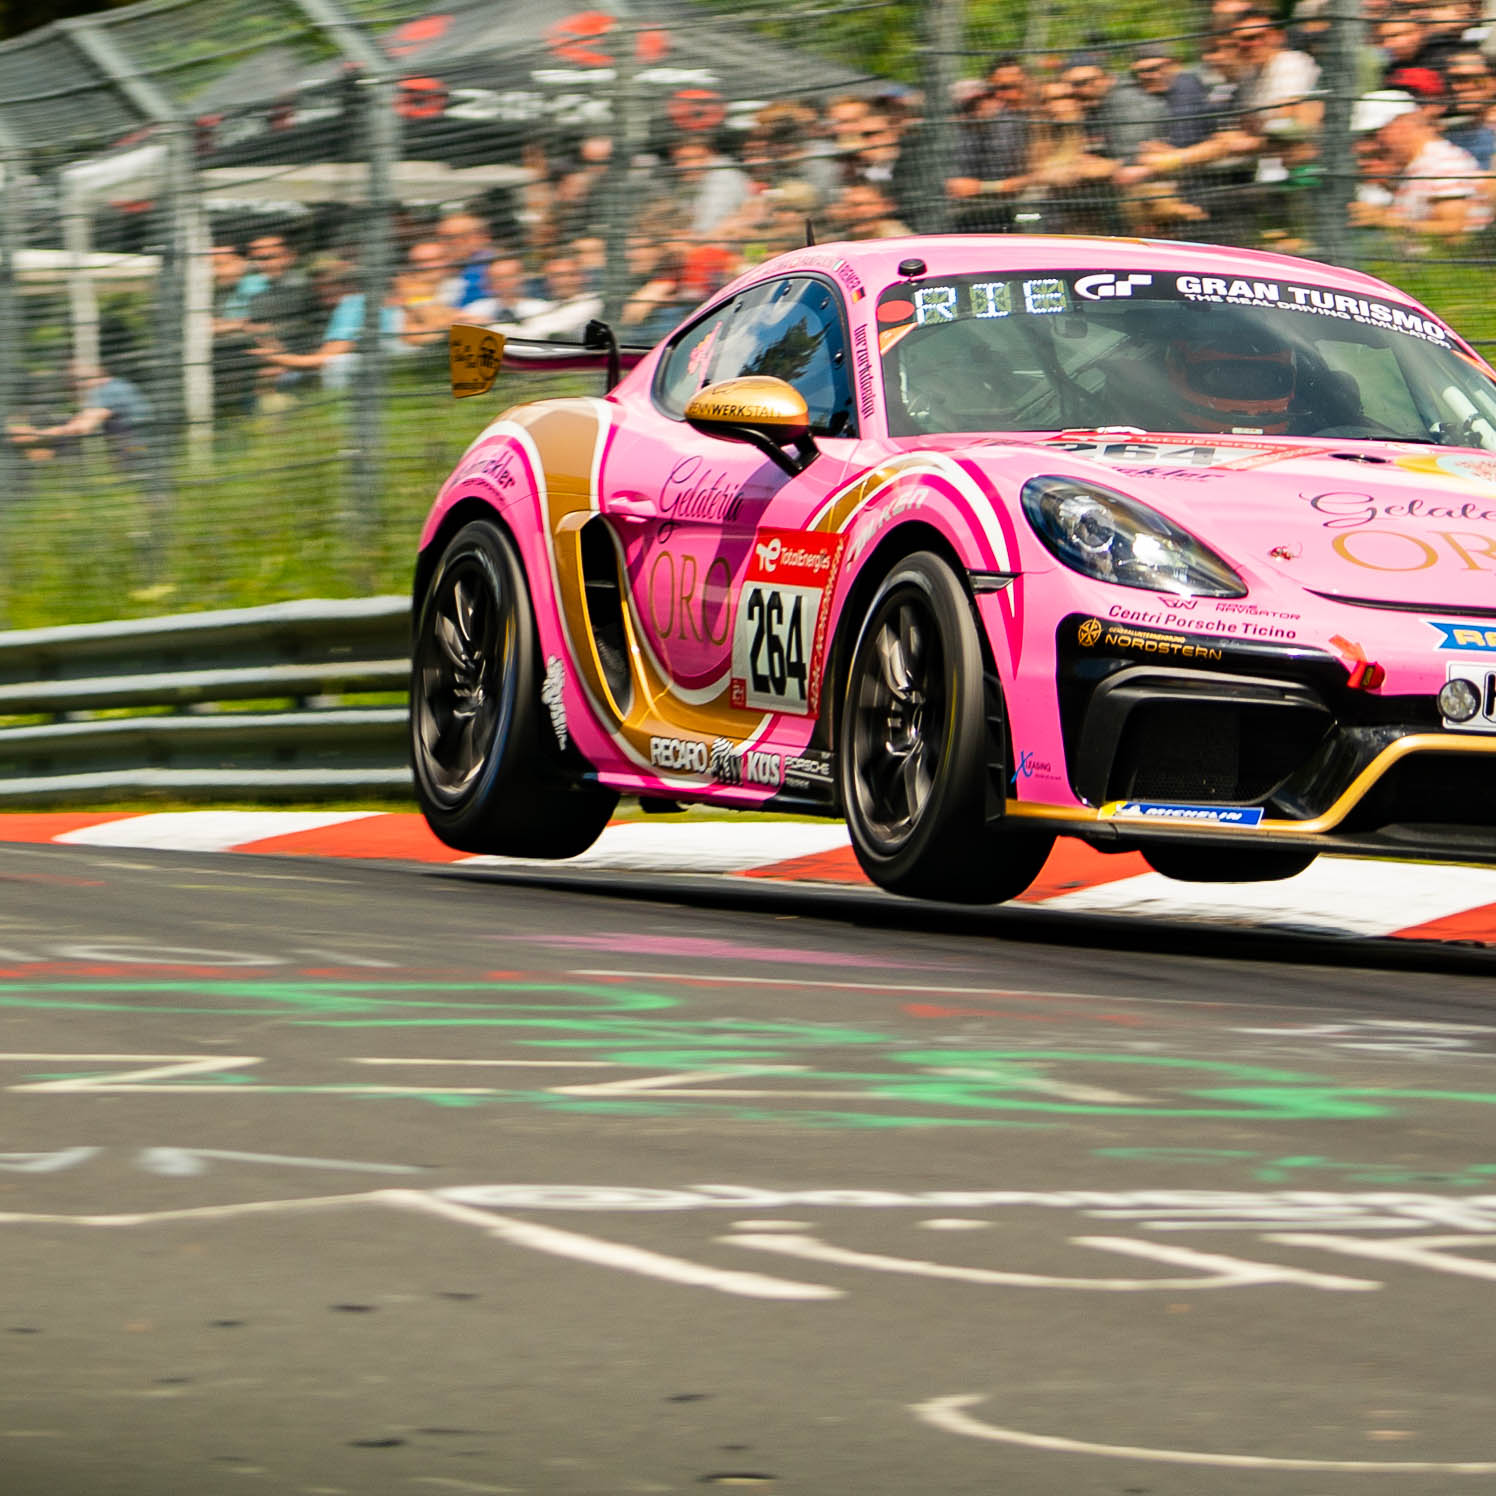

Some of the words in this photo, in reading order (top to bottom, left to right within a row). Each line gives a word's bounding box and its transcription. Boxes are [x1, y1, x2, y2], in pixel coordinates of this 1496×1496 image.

[914, 278, 1066, 327] RIE
[1176, 275, 1280, 301] GRAN
[1289, 286, 1448, 340] TURISMO
[1184, 293, 1224, 303] THE
[1226, 296, 1275, 308] REAL
[1277, 301, 1352, 320] DRIVING
[1353, 314, 1453, 349] SIMULATOR
[658, 456, 745, 544] Gelateria
[780, 545, 832, 576] TotalEnergies
[649, 551, 732, 645] ORO
[747, 587, 808, 701] 264
[1108, 605, 1161, 625] Centri
[1164, 614, 1238, 634] Porsche
[1241, 623, 1297, 640] Ticino
[1105, 634, 1222, 661] NORDSTERN
[650, 736, 708, 773] RECARO
[784, 755, 831, 776] PORSCHE
[1145, 807, 1243, 821] MICHELIN
